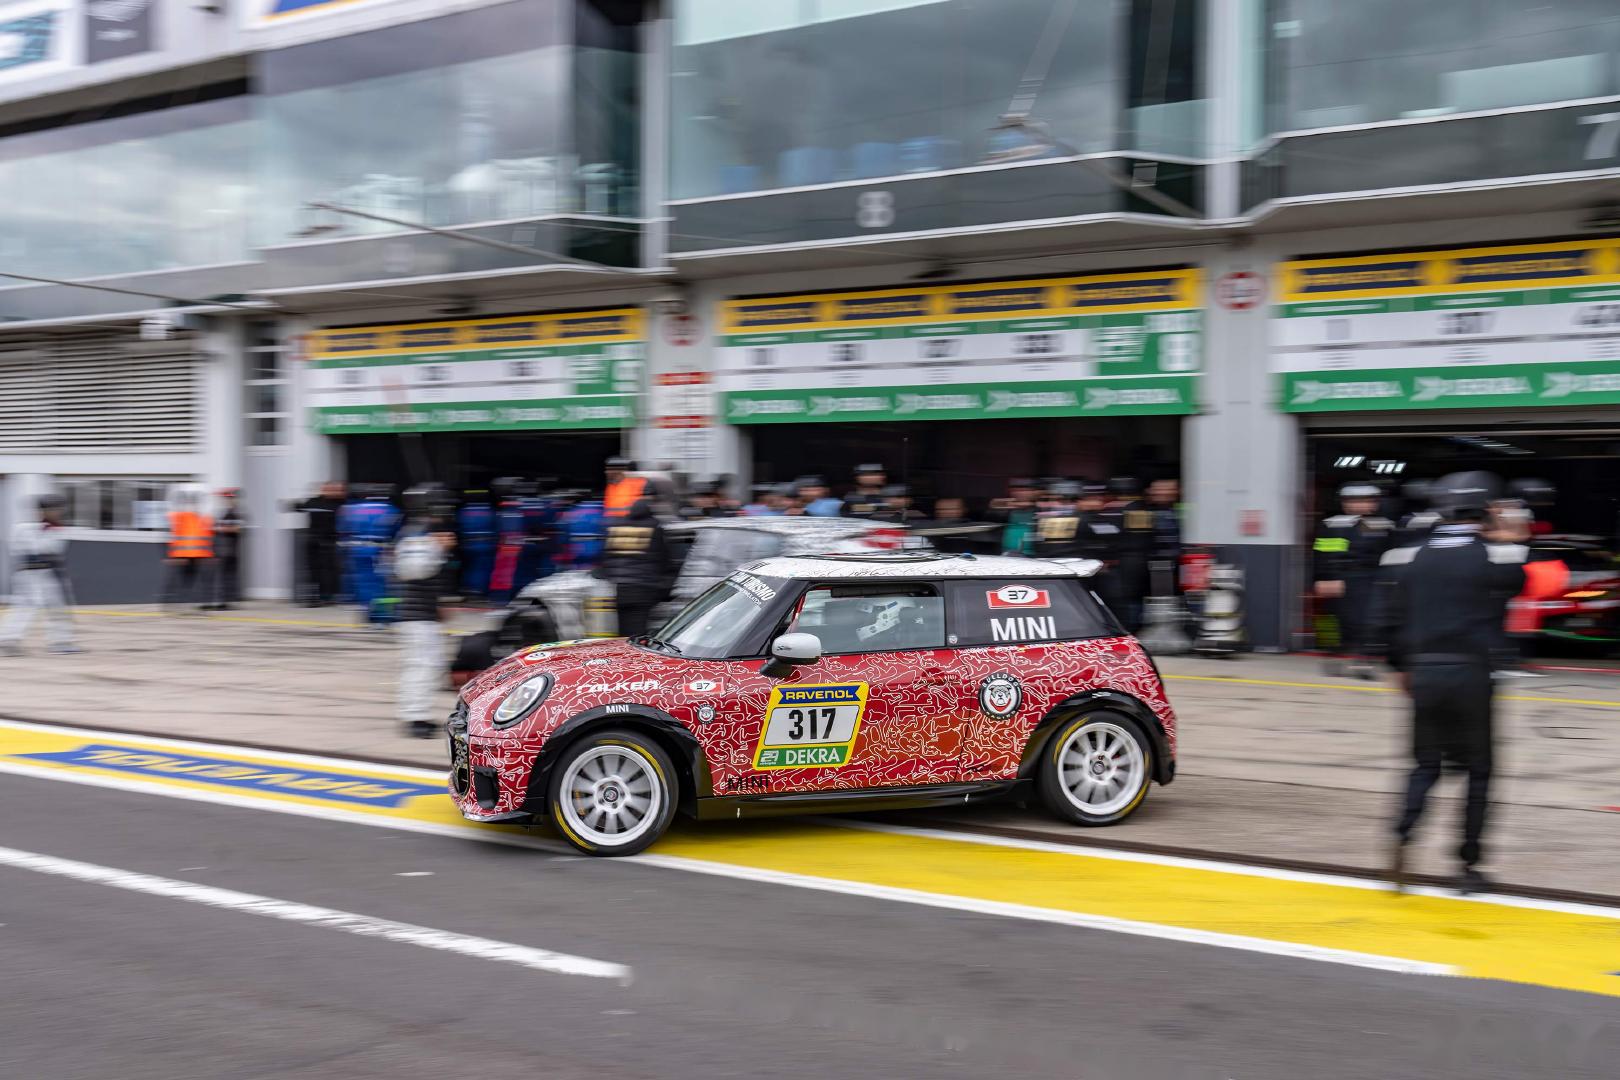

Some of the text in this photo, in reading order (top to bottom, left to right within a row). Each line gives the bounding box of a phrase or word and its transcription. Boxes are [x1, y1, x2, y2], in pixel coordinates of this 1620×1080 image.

[1007, 590, 1029, 600] 37
[990, 616, 1057, 642] MINI
[982, 673, 1020, 688] BULLDOG
[785, 690, 854, 701] RAVENOL
[605, 704, 630, 714] MINI
[788, 708, 837, 741] 317
[785, 748, 841, 765] DEKRA
[727, 775, 769, 791] MINI
